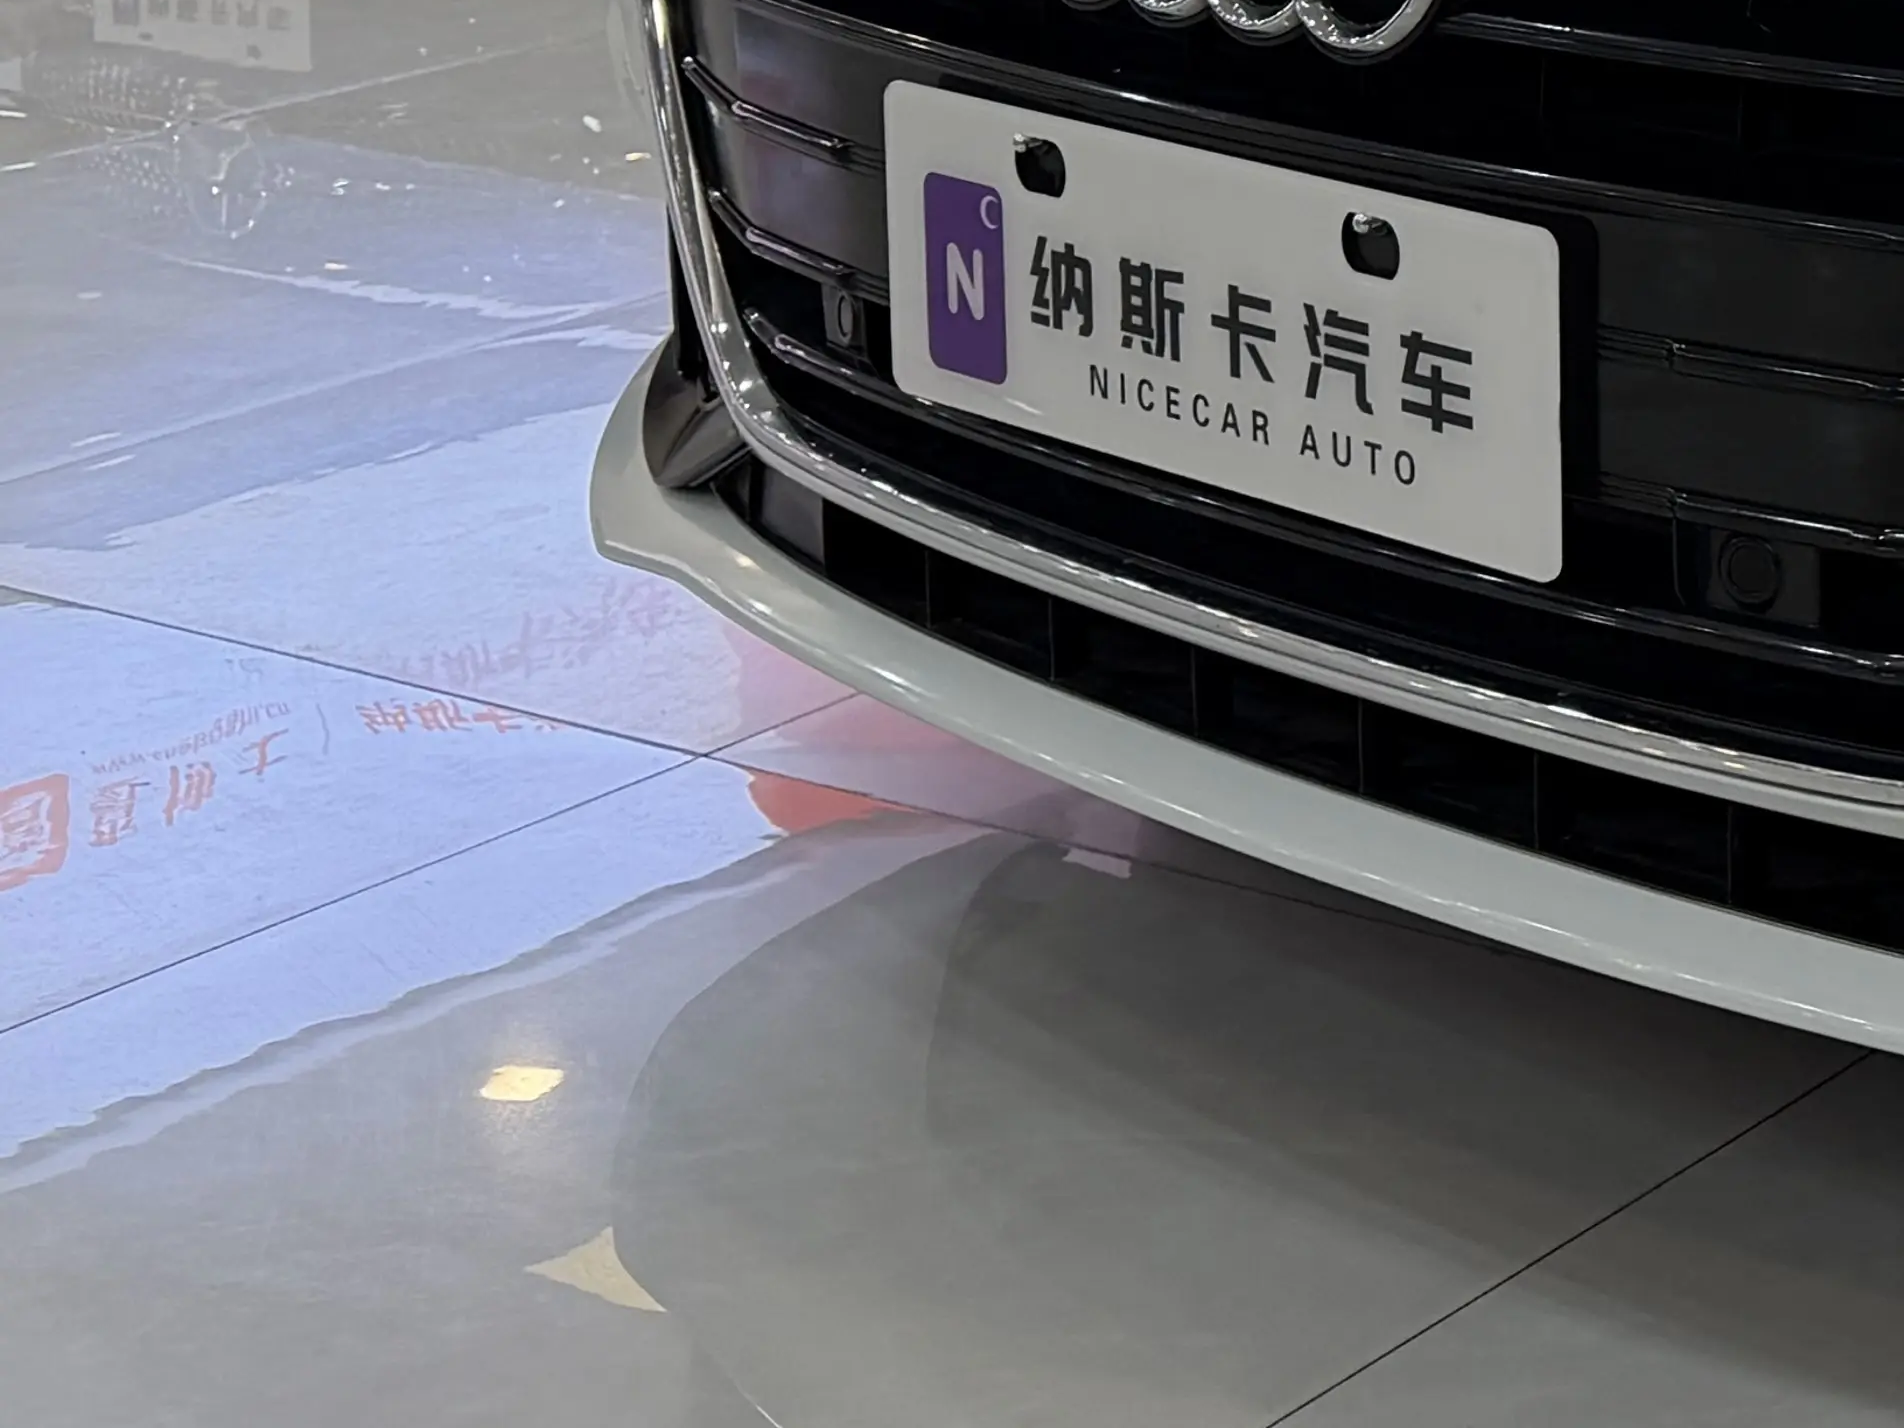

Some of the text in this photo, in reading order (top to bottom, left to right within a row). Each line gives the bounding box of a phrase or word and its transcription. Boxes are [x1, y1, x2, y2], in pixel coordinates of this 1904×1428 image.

[945, 241, 985, 321] N
[1029, 235, 1475, 434] 纳斯卡汽车
[1089, 364, 1417, 486] NICECAR AUTO
